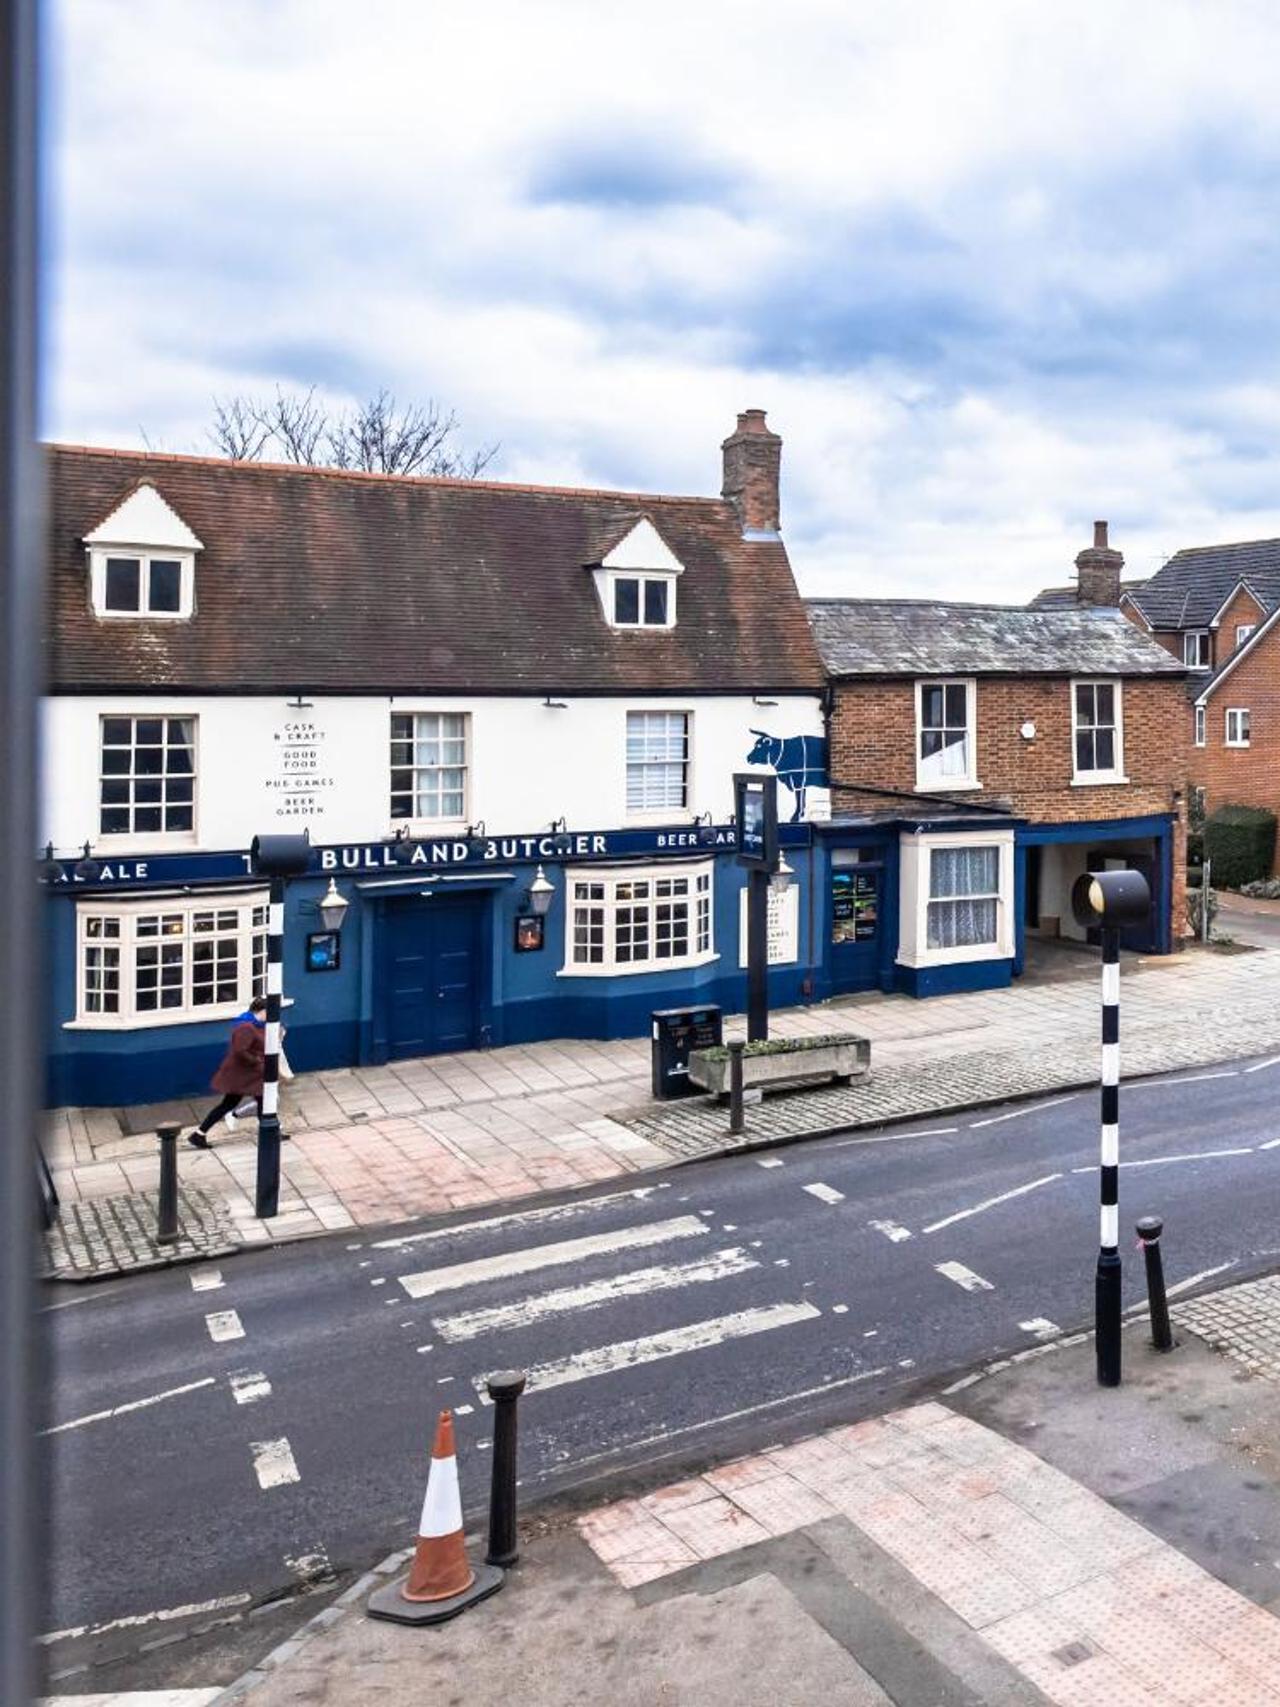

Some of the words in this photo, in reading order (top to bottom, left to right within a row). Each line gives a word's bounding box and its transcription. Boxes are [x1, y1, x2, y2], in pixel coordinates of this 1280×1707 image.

[284, 723, 315, 731] CASK
[287, 732, 325, 740] CRAFT
[284, 751, 317, 759] GOOD
[284, 761, 317, 769] FOOD
[295, 778, 334, 786] GAMES
[285, 798, 315, 806] BEER
[275, 807, 324, 816] GARDEN
[657, 833, 697, 847] BEER
[322, 847, 397, 869] BULL
[411, 844, 468, 864] AND
[100, 863, 148, 881] ALE
